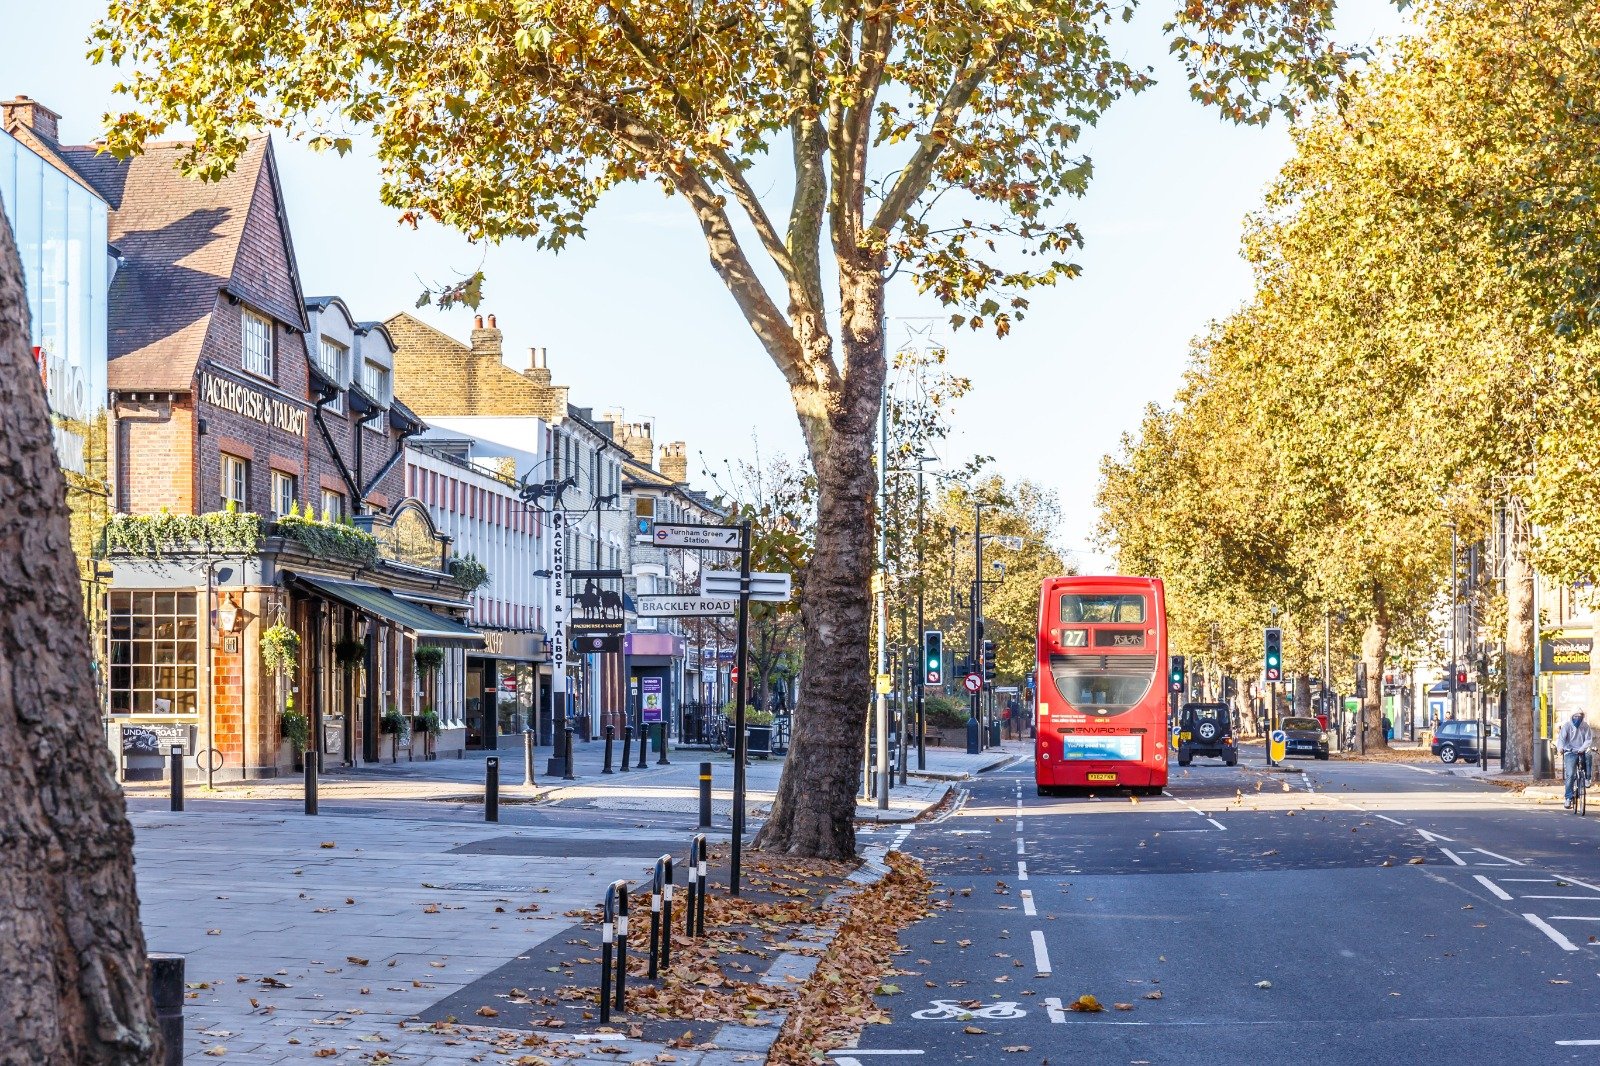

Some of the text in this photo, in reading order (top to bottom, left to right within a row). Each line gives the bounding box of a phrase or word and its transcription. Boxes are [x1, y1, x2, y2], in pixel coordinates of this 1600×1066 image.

[202, 371, 308, 437] PACKHORSE & TALBOT
[670, 528, 724, 538] Turnham Green
[684, 536, 710, 544] Station
[553, 523, 563, 596] PACKHORSE
[642, 601, 731, 611] BRACKLEY ROAD
[1064, 630, 1084, 646] 27
[555, 621, 563, 669] TALBOT
[1553, 654, 1590, 665] specialists
[155, 729, 184, 737] ROAST
